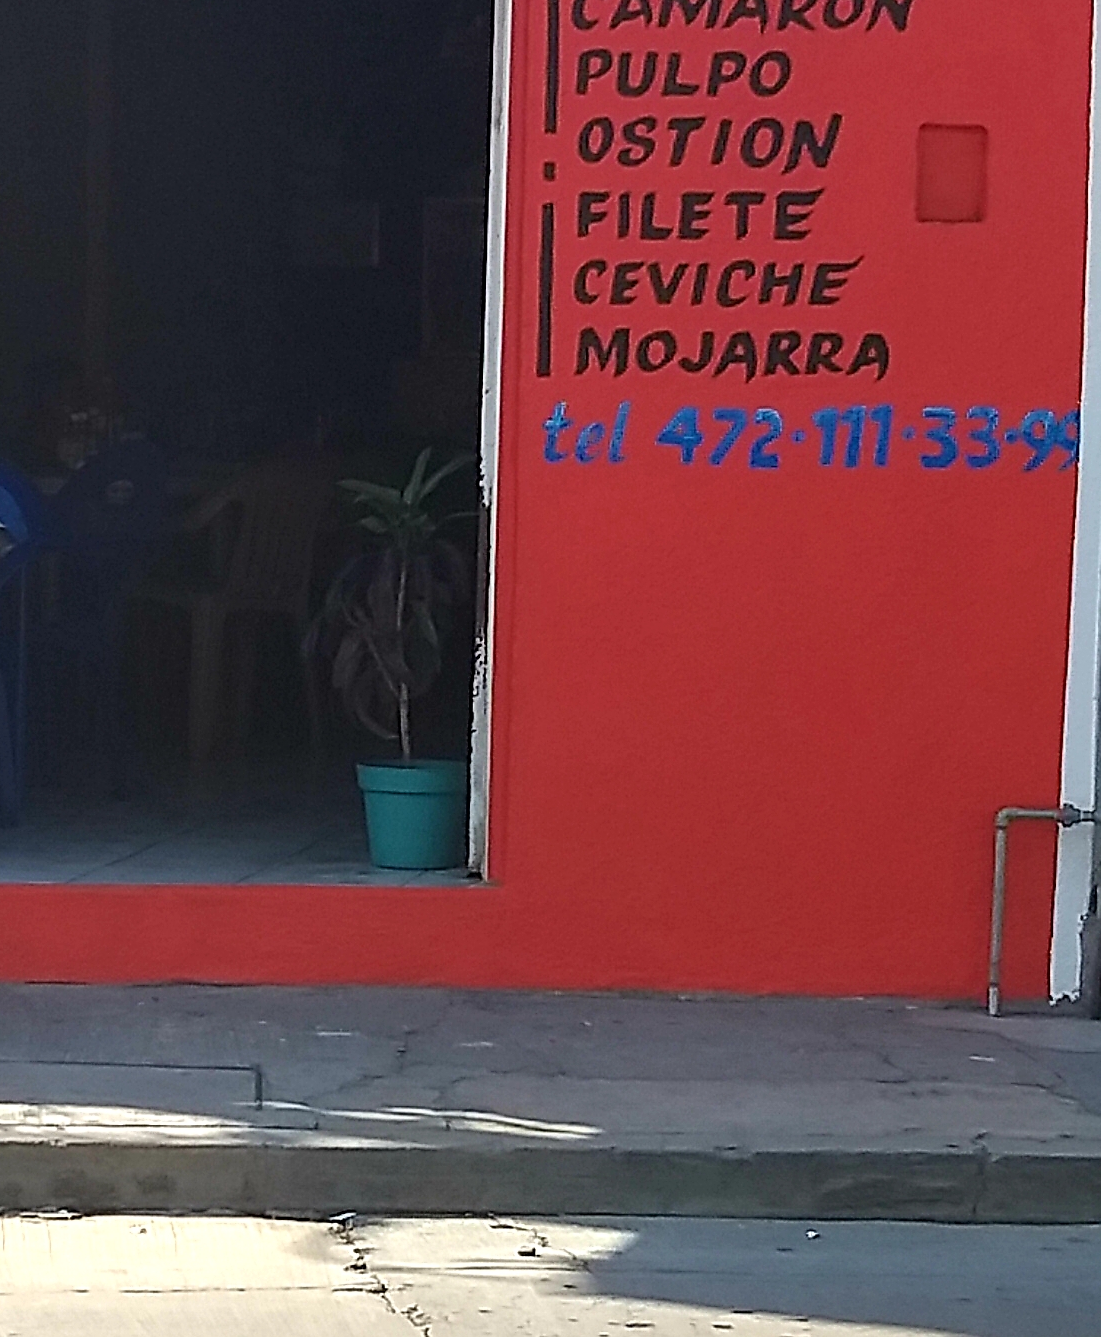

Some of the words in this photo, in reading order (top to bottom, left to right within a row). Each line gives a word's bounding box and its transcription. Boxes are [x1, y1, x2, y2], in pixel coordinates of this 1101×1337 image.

[574, 49, 793, 97] PULPO
[576, 114, 843, 175] OSTION
[575, 188, 826, 241] FILETE
[573, 255, 865, 308] CEVICHE
[573, 327, 891, 382] MOJARRA
[542, 400, 632, 463] tel
